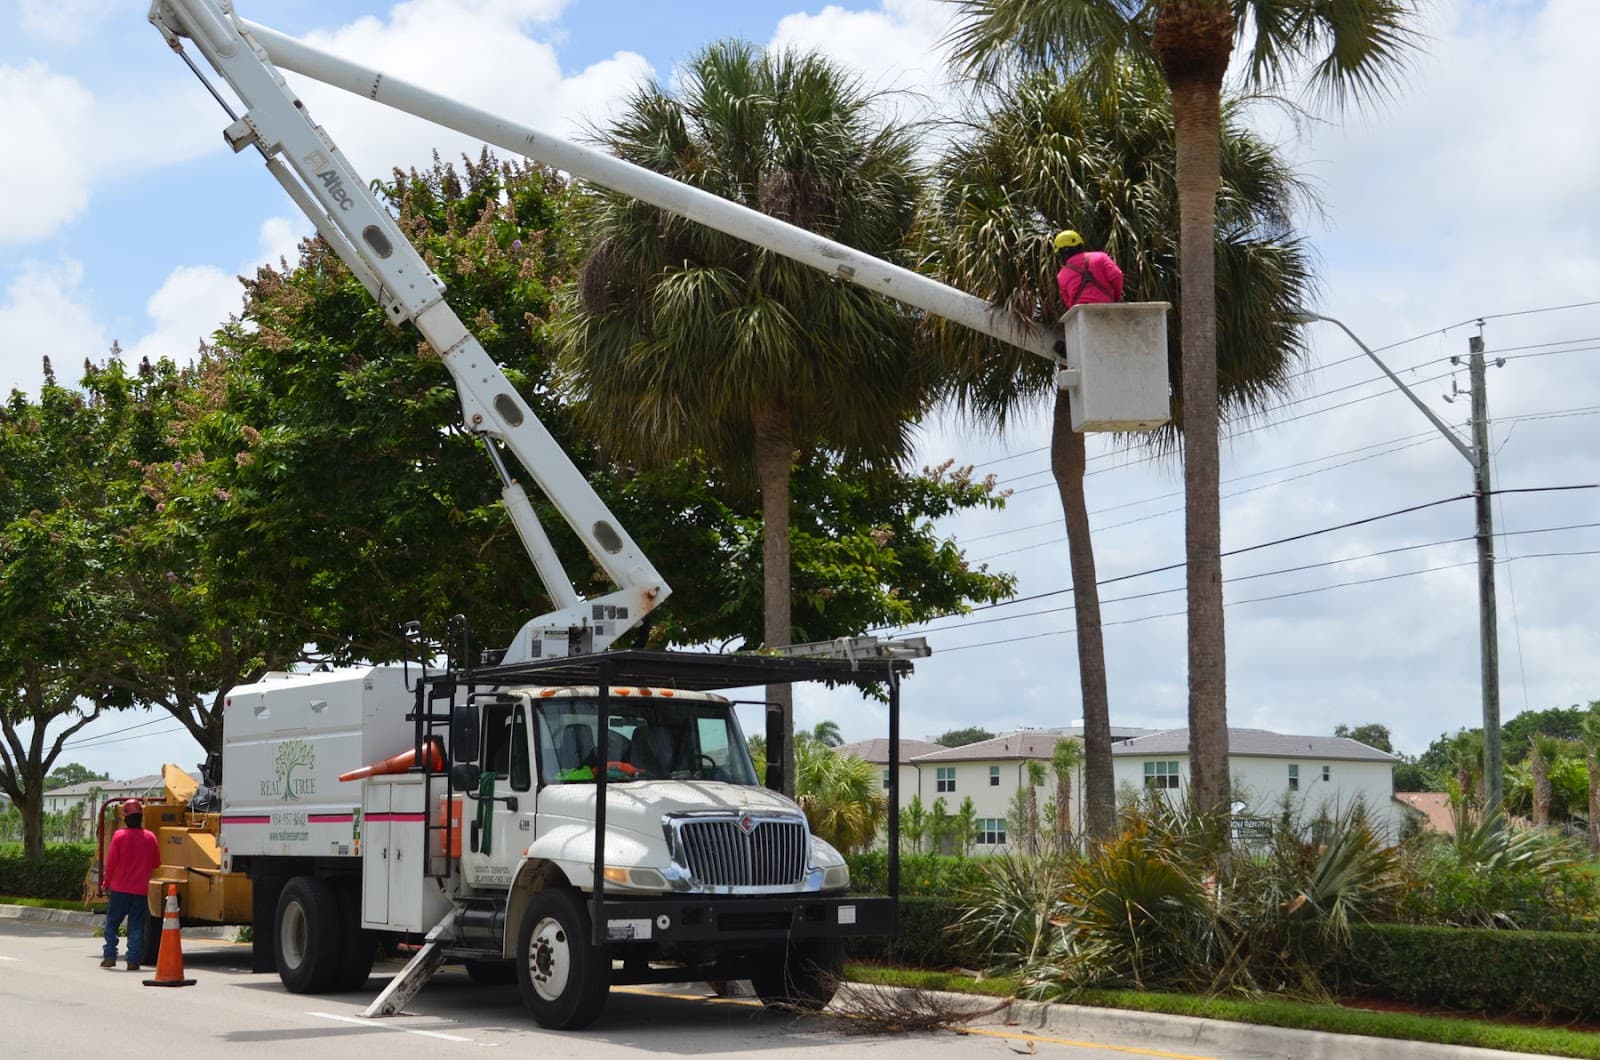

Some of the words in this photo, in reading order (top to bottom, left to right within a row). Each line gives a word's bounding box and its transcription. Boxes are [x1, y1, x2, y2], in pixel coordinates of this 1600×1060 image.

[317, 170, 354, 211] Altec
[260, 780, 282, 796] REAL
[294, 778, 316, 796] TREE
